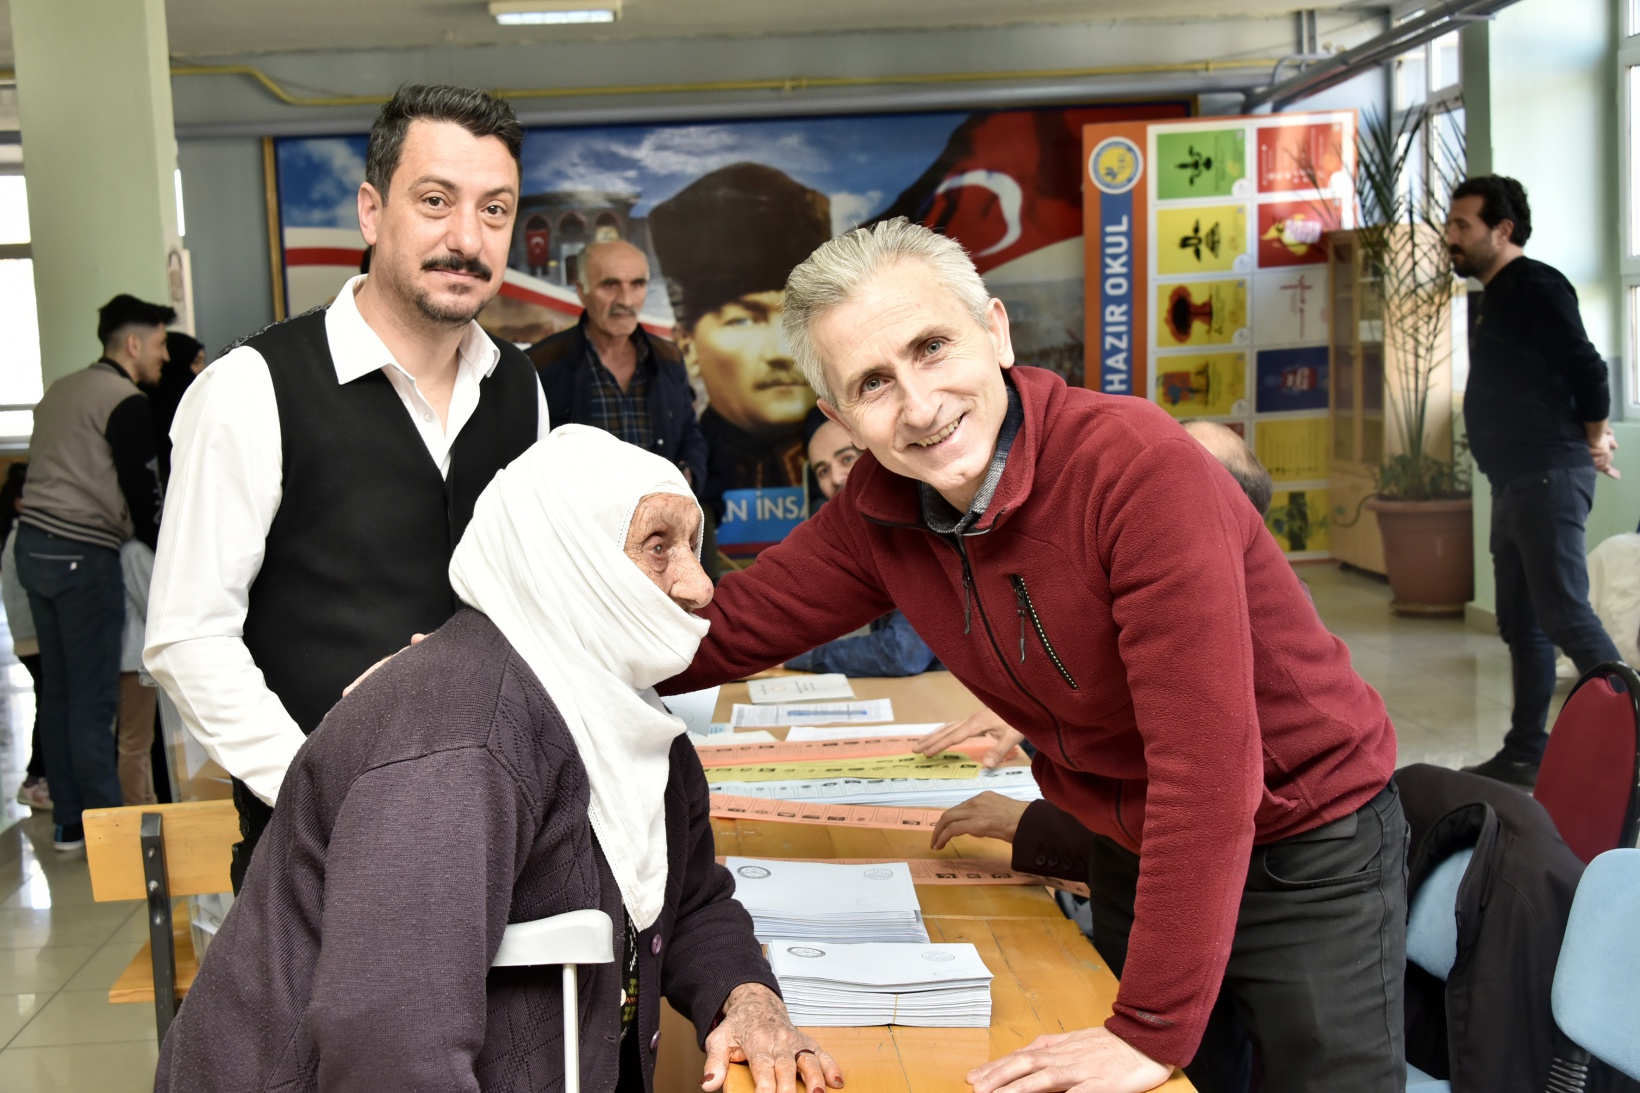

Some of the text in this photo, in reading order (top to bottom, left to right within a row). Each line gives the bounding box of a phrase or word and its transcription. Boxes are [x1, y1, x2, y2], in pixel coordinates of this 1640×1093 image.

[1104, 214, 1129, 296] OKUL
[1104, 303, 1129, 392] HAZIR
[722, 498, 748, 523] N
